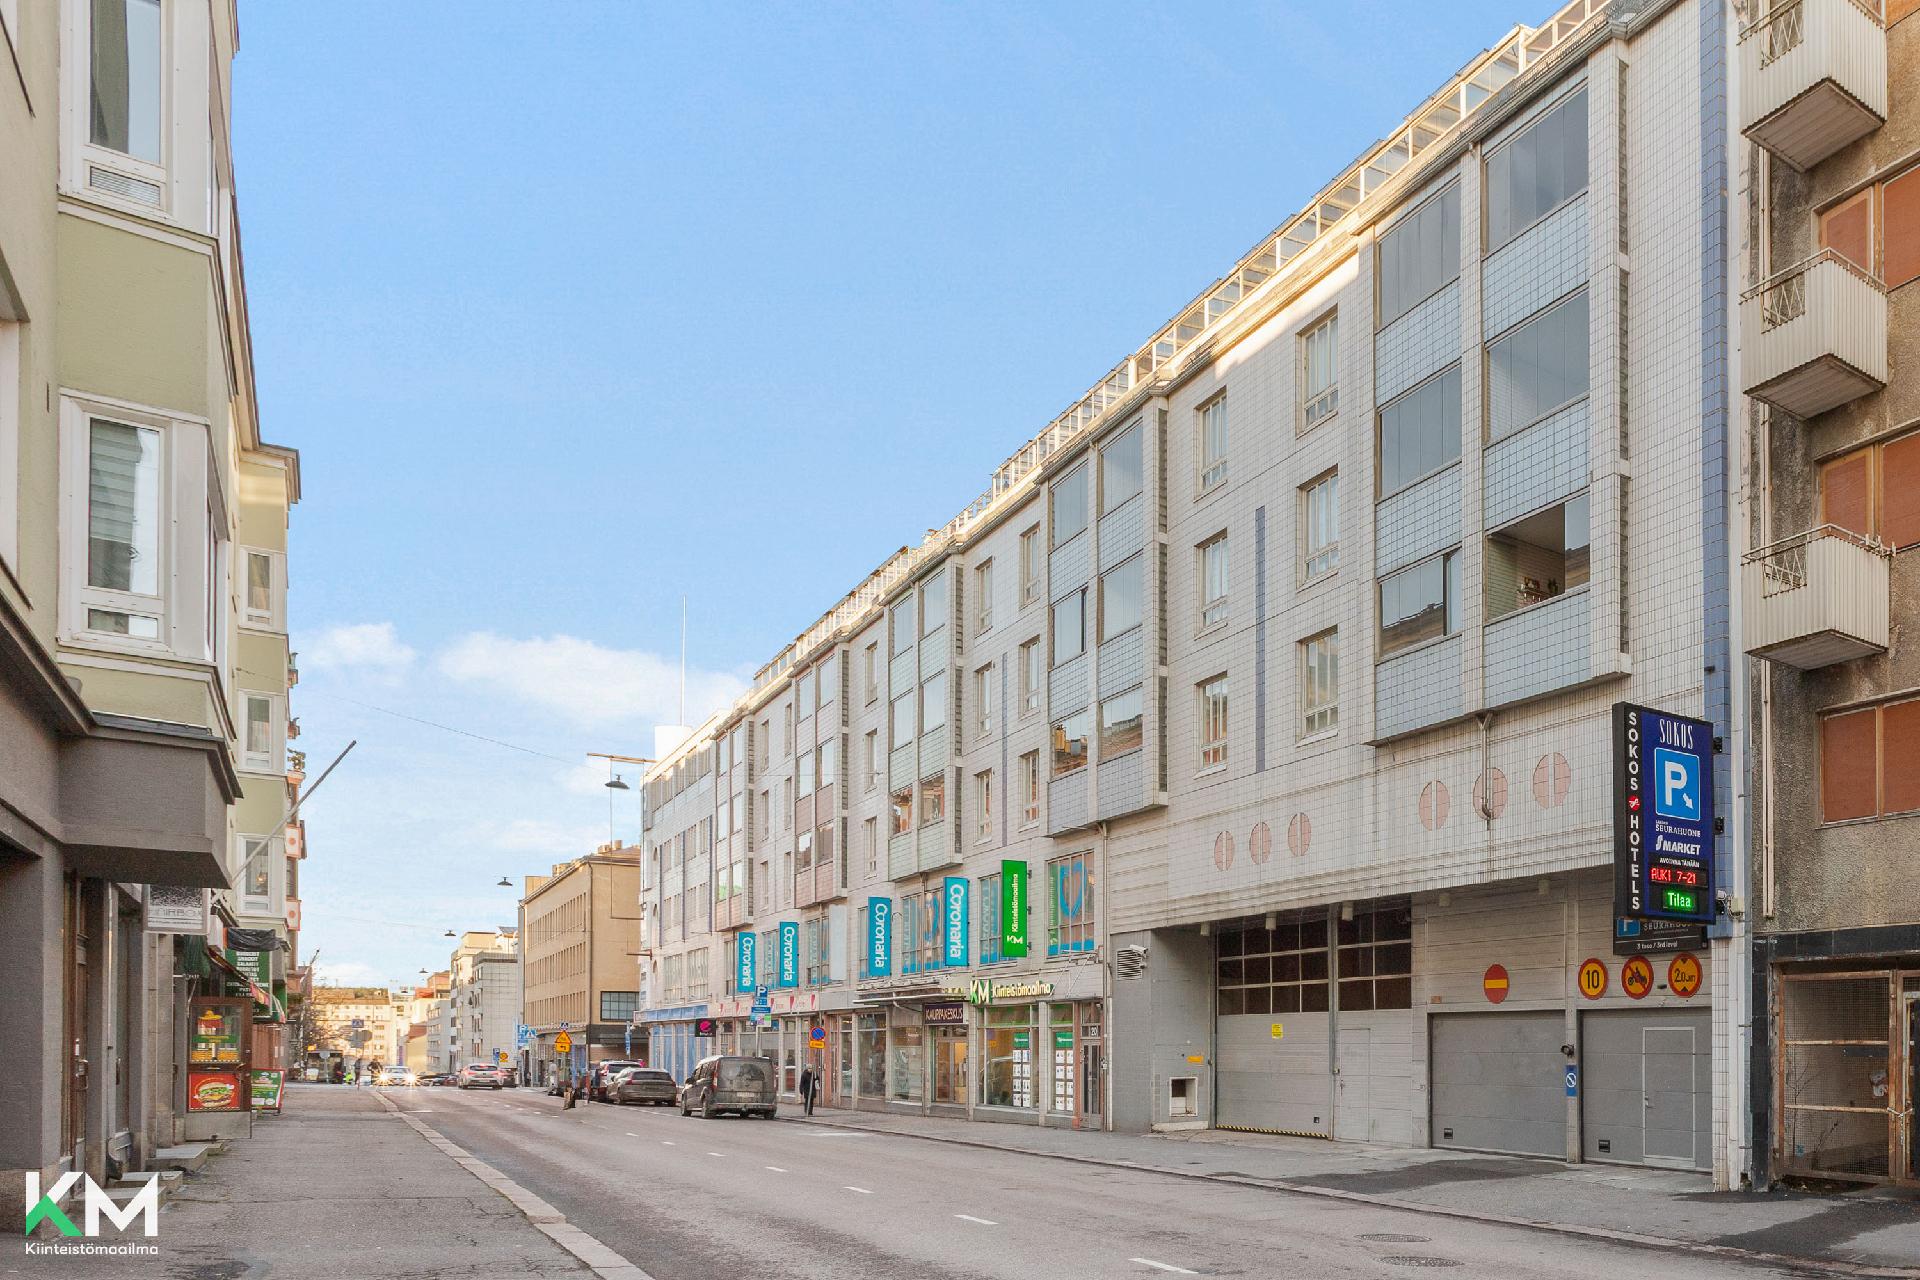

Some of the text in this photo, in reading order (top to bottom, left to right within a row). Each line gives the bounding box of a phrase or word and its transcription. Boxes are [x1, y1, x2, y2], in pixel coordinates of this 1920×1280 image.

[1659, 718, 1694, 750] SOKOS
[1664, 760, 1688, 806] P
[1628, 711, 1640, 910] SOKOS HOTELS
[1655, 823, 1701, 838] SEURAHUONE
[1663, 840, 1701, 856] MARKET
[1676, 870, 1696, 885] 7-21
[1011, 873, 1019, 933] Kiinteistömaailma
[1667, 891, 1691, 907] Tilaa
[949, 883, 964, 958] Coronaria
[875, 903, 888, 968] Coronaria
[742, 936, 754, 987] Coronaria
[783, 926, 795, 982] Coronaria
[757, 986, 767, 997] P
[969, 978, 1054, 1005] KM Kiinteistömaailma
[1585, 969, 1600, 989] 10
[1090, 1027, 1098, 1036] 20
